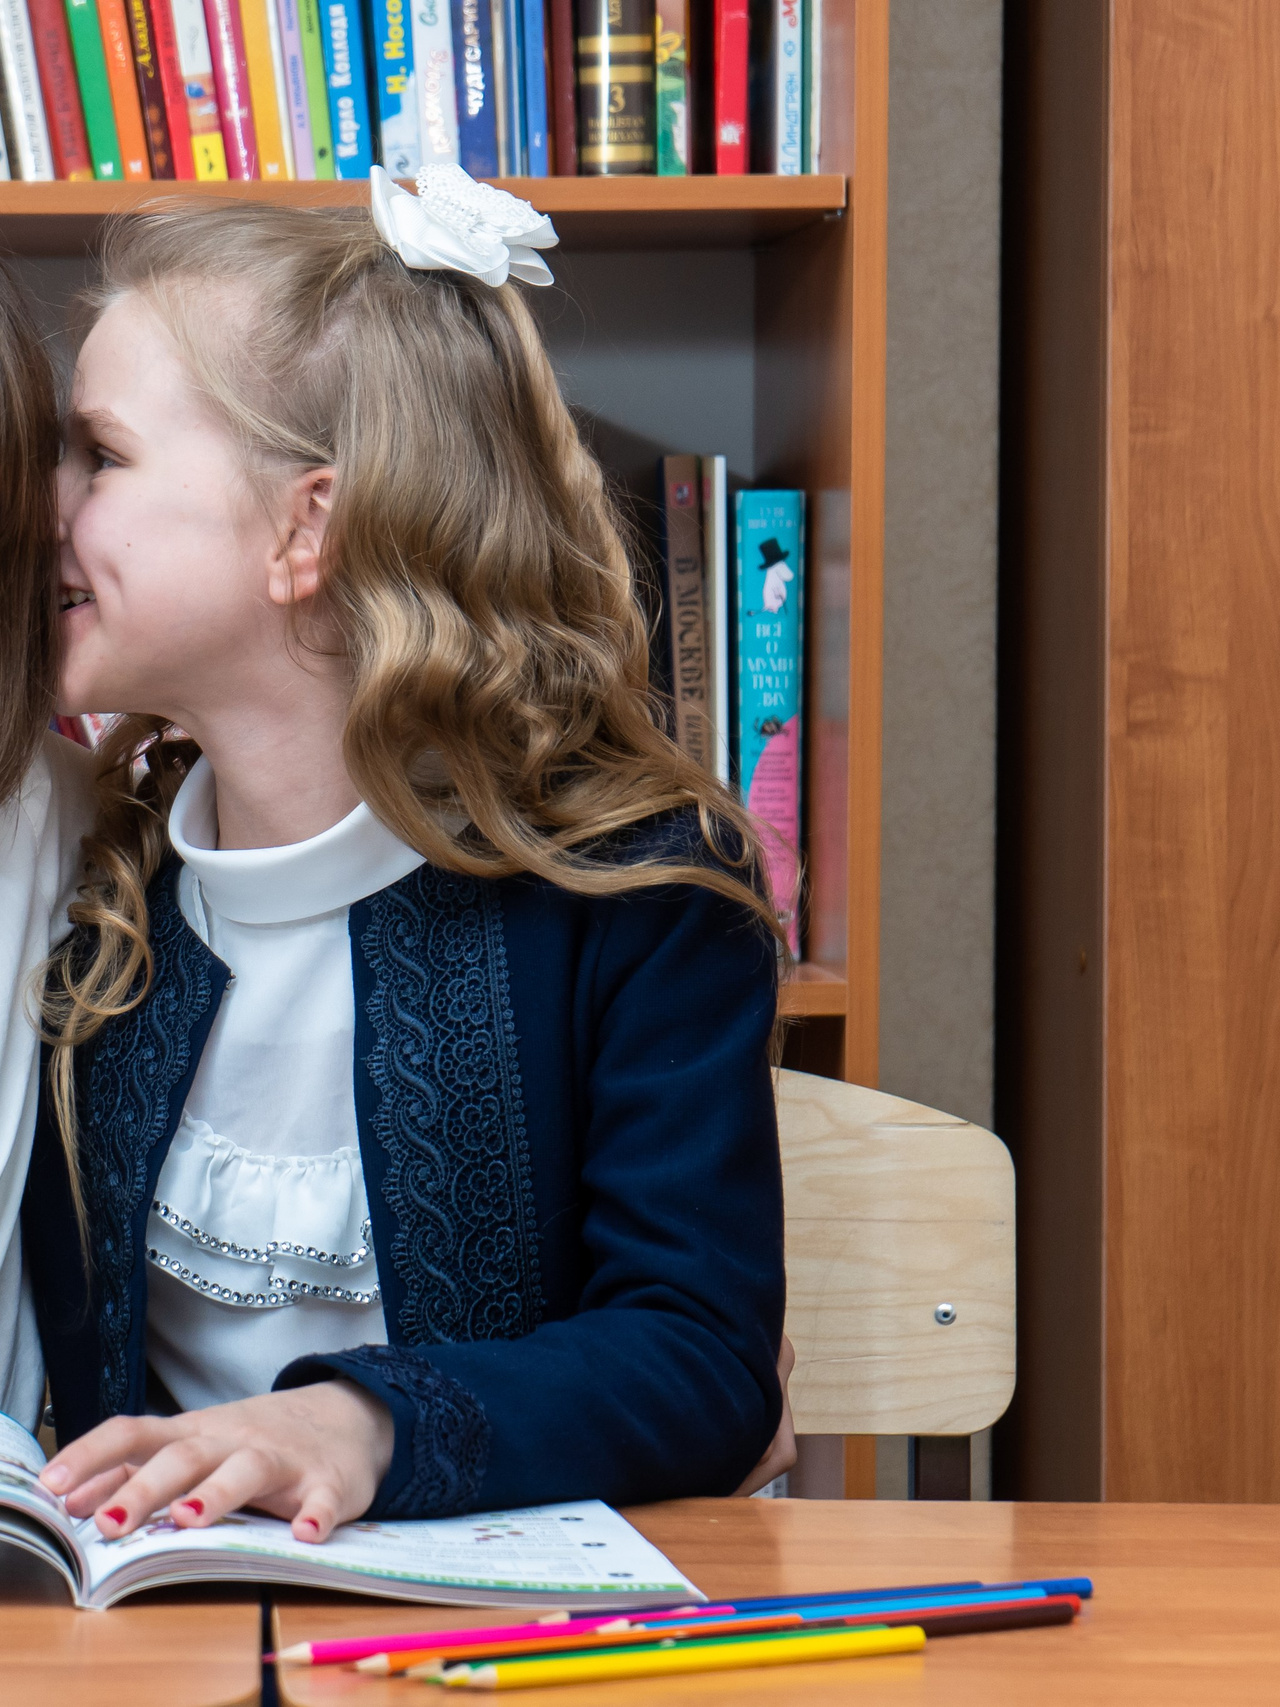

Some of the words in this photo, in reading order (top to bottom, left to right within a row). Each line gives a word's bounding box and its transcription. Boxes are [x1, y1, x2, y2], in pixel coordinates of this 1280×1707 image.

[329, 4, 352, 88] Коллоди
[386, 66, 408, 94] Н.
[336, 96, 361, 158] Карло
[675, 556, 698, 574] В
[676, 583, 705, 702] МОСКВЕ
